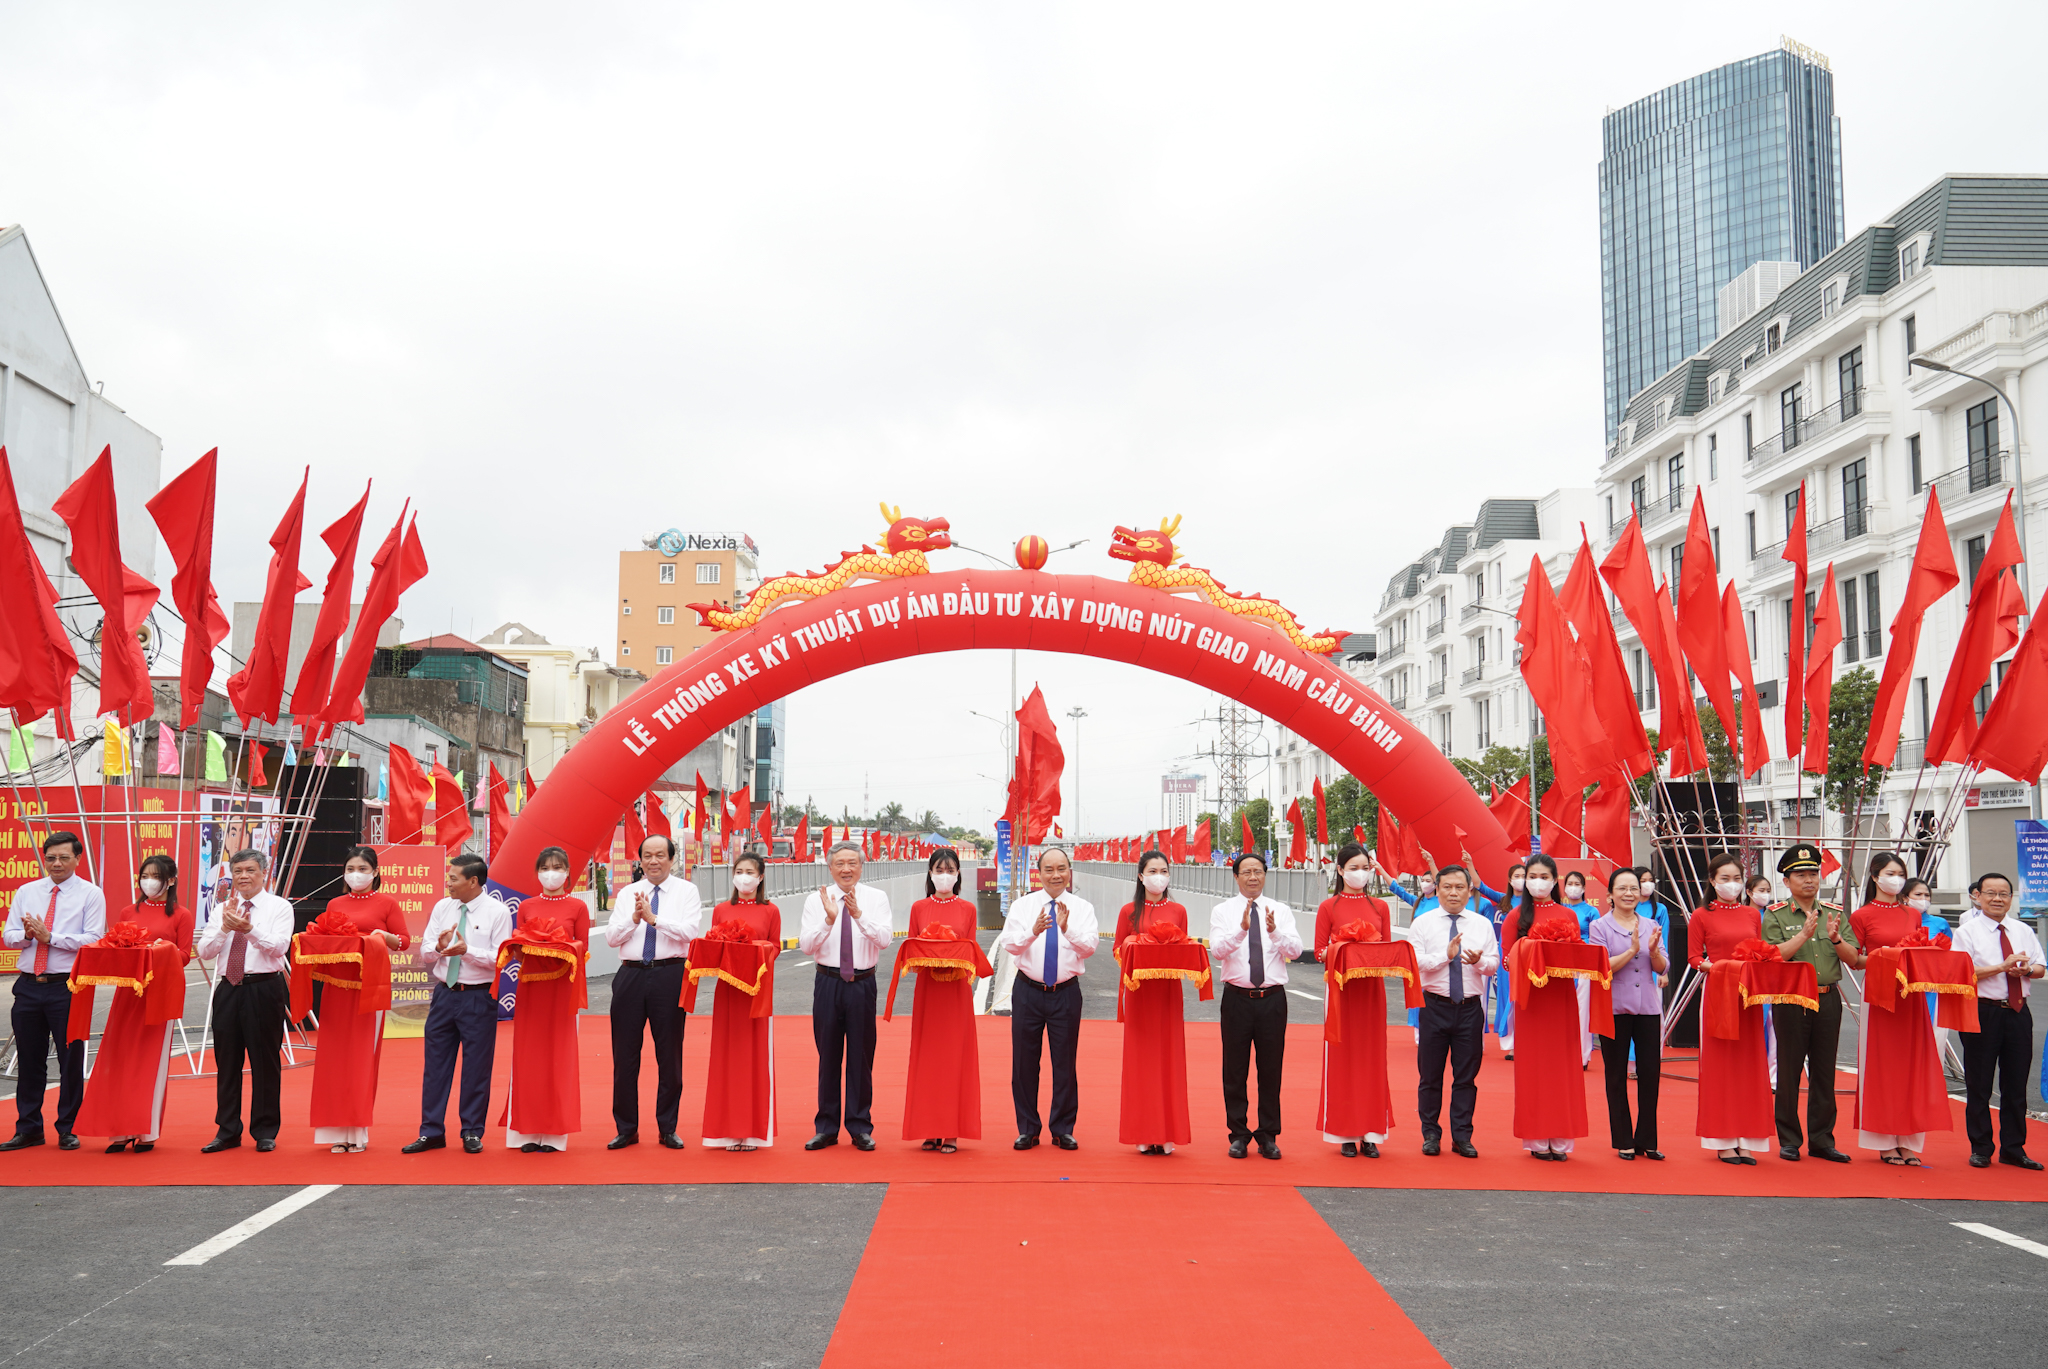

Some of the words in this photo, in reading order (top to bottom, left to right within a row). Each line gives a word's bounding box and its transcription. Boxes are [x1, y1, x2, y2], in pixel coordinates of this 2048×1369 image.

[688, 534, 737, 549] Nexia
[622, 717, 657, 757] LỄ
[651, 672, 728, 731] THÔNG
[724, 653, 760, 686] XE
[758, 633, 791, 669] KỸ
[791, 609, 864, 652] THUẬT
[867, 596, 901, 629] DỰ
[907, 591, 940, 620] ÁN
[943, 583, 990, 615] ĐẦU
[994, 591, 1024, 616] TƯ
[1029, 591, 1075, 621] XÂY
[1080, 600, 1144, 633] DỰNG
[1148, 612, 1196, 645] NÚT
[1196, 626, 1250, 665] GIAO
[1252, 649, 1308, 692] NAM
[1306, 677, 1354, 715] CẦU
[1348, 703, 1402, 753] BÍNH
[0, 828, 13, 849] HÍ
[378, 864, 404, 879] HIỆT
[407, 864, 430, 879] LIỆT
[401, 881, 433, 894] MỪNG
[391, 970, 428, 983] PHÒNG
[392, 988, 429, 1001] PHÓNG
